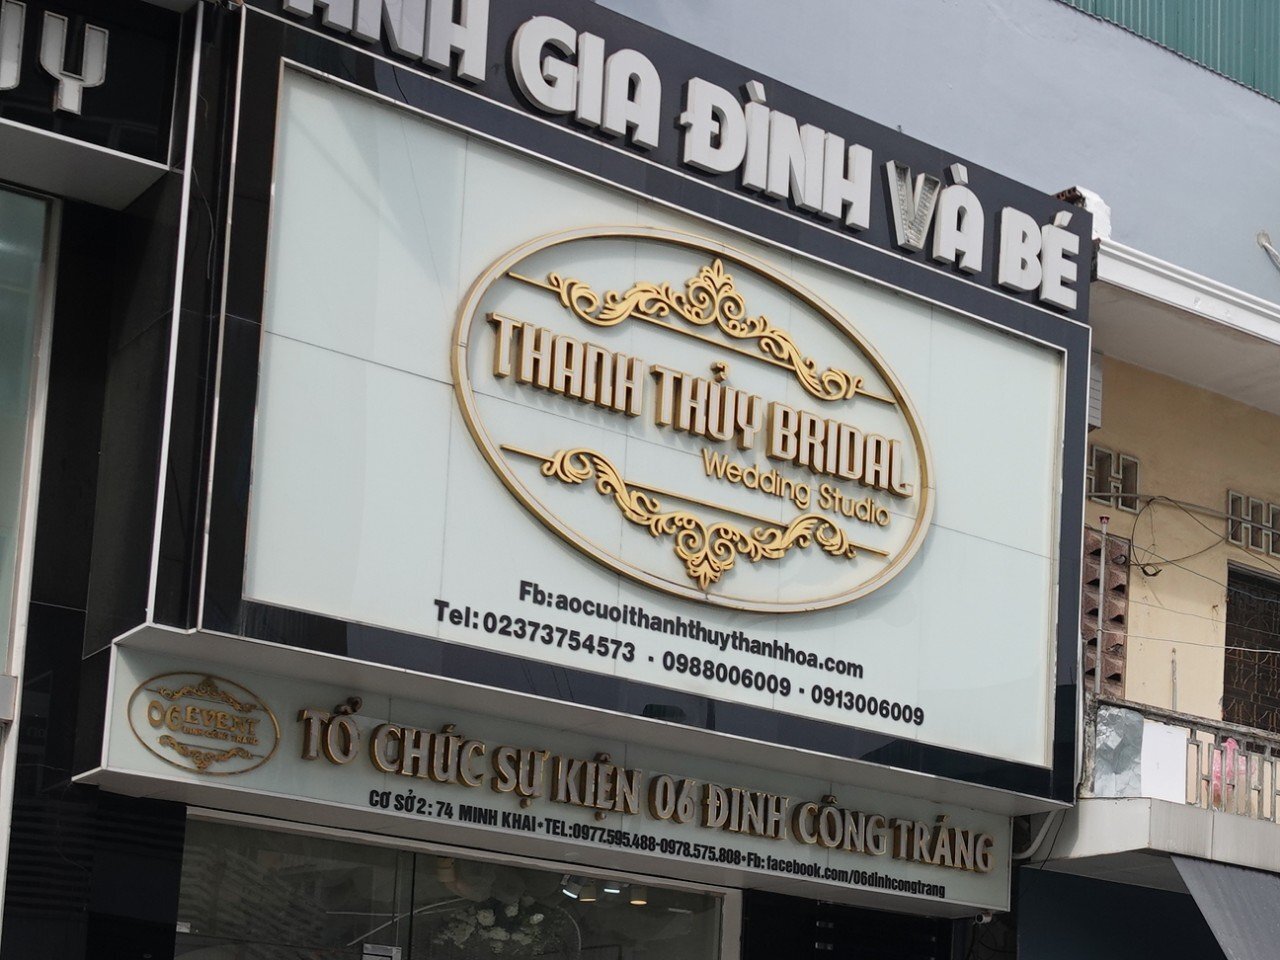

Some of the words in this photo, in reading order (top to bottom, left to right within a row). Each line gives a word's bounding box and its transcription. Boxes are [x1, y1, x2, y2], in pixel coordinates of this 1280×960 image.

[283, 0, 490, 83] NH
[509, 15, 662, 150] GIA
[677, 77, 873, 232] ĐÌNH
[885, 162, 985, 274] VÀ
[998, 206, 1079, 312] BÉ
[486, 311, 644, 417] THANH
[650, 361, 763, 450] THỦY
[767, 400, 914, 499] BRIDAL
[700, 448, 813, 510] Wedding
[818, 484, 891, 528] Studio
[662, 650, 792, 697] 0988006009
[811, 684, 925, 726] 0913006009
[299, 696, 363, 765] TỔ
[370, 723, 487, 788] CHỨC
[491, 744, 549, 809] SỰ
[552, 752, 642, 821] KIỆN
[649, 773, 697, 824] 06
[702, 782, 789, 840] ĐINH
[792, 794, 888, 856] CÔNG
[890, 815, 994, 874] TRÁNG
[436, 800, 453, 819] 74
[459, 804, 498, 826] MINH
